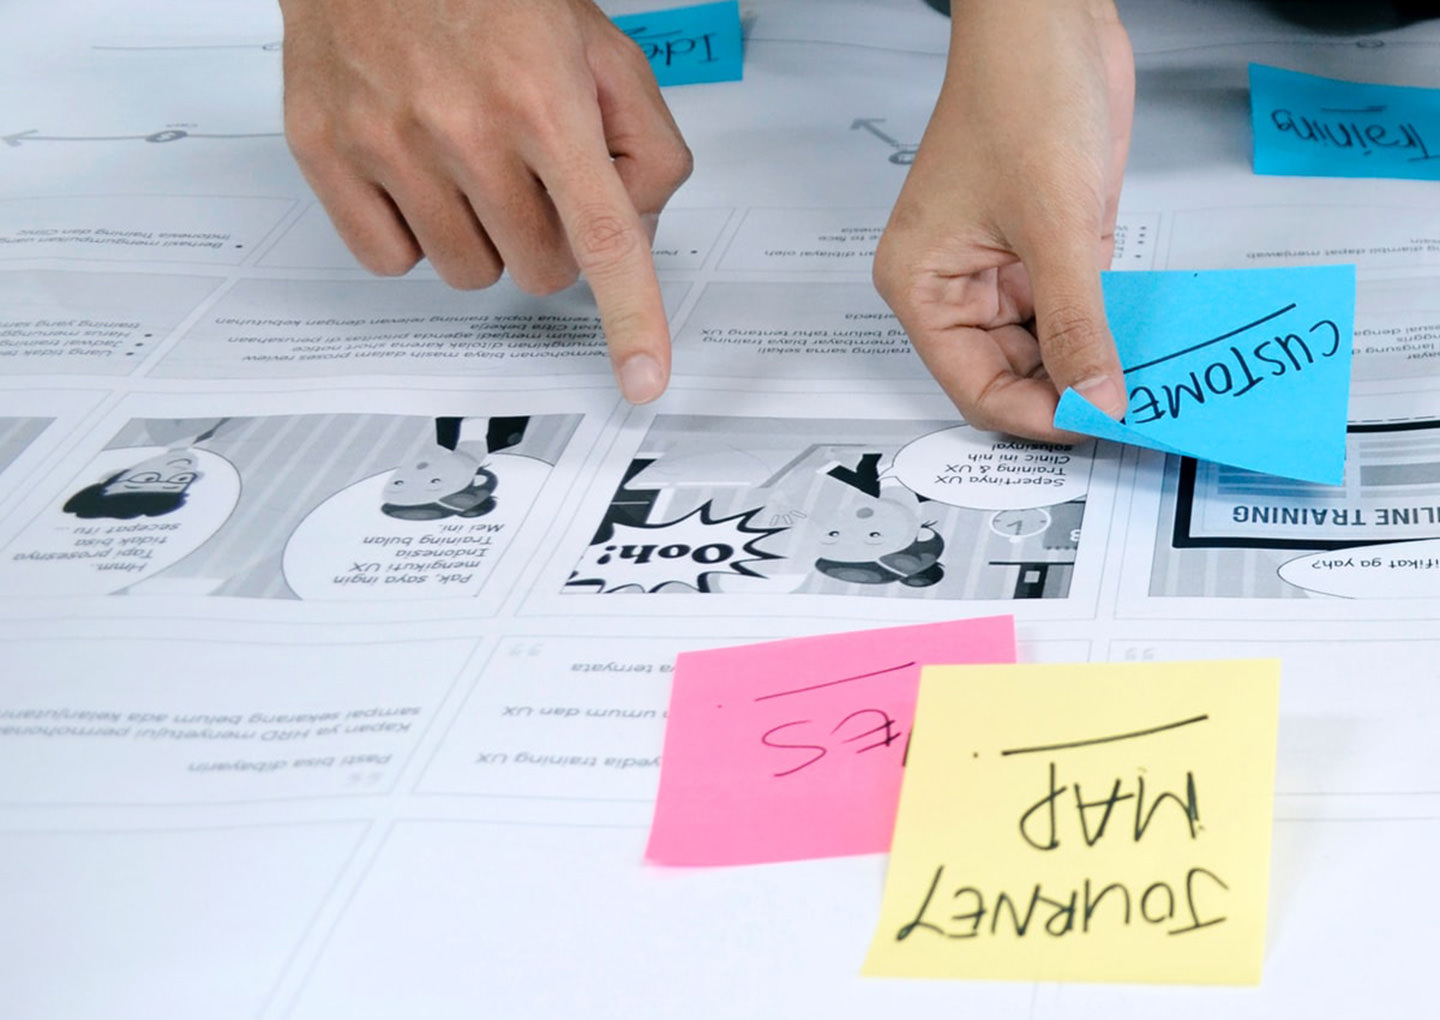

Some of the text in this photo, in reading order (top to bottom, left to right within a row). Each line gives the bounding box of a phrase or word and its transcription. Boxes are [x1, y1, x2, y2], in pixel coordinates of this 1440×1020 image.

[640, 32, 720, 67] Ide
[412, 332, 474, 340] agenda
[476, 331, 542, 340] menjadi
[545, 332, 597, 340] belum
[698, 329, 722, 337] UX
[727, 328, 788, 337] tentang
[791, 330, 828, 338] tahu
[832, 330, 882, 338] belum
[226, 335, 322, 344] perusahaan
[449, 341, 504, 349] ditolak
[702, 336, 762, 346] training
[766, 338, 807, 346] biaya
[291, 345, 344, 353] notice
[346, 343, 386, 351] short
[757, 347, 801, 355] sekali
[1364, 343, 1435, 355] langsung
[240, 349, 506, 363] biaya masih dalam proses review
[1126, 320, 1340, 425] CUSTOME
[967, 453, 1071, 465] Clinic ini nih
[944, 463, 1067, 476] Training & UX
[933, 474, 1066, 488] Sepertinya UX
[1231, 504, 1367, 527] TRAINING
[469, 523, 506, 533] Mei
[362, 534, 493, 548] Training bulan
[113, 548, 154, 560] Tapi
[394, 548, 490, 560] Indonesia
[595, 543, 734, 565] Ooh!
[347, 559, 480, 573] mengikuti UX
[1311, 557, 1355, 570] yah?
[1360, 557, 1382, 569] ga
[332, 572, 380, 586] ingin
[383, 573, 429, 585] saya
[567, 662, 654, 674] ternyata
[343, 707, 423, 721] sampai
[500, 706, 535, 717] UX
[539, 707, 581, 718] dan
[583, 708, 658, 718] umum
[127, 713, 169, 723] ada
[247, 712, 341, 724] sekarang
[344, 722, 413, 734] Kapan
[259, 729, 311, 742] HRD
[292, 756, 337, 768] bisa
[474, 752, 662, 768] yedia training UX
[1017, 762, 1205, 852] MAP
[895, 865, 1229, 943] JOURNEY
